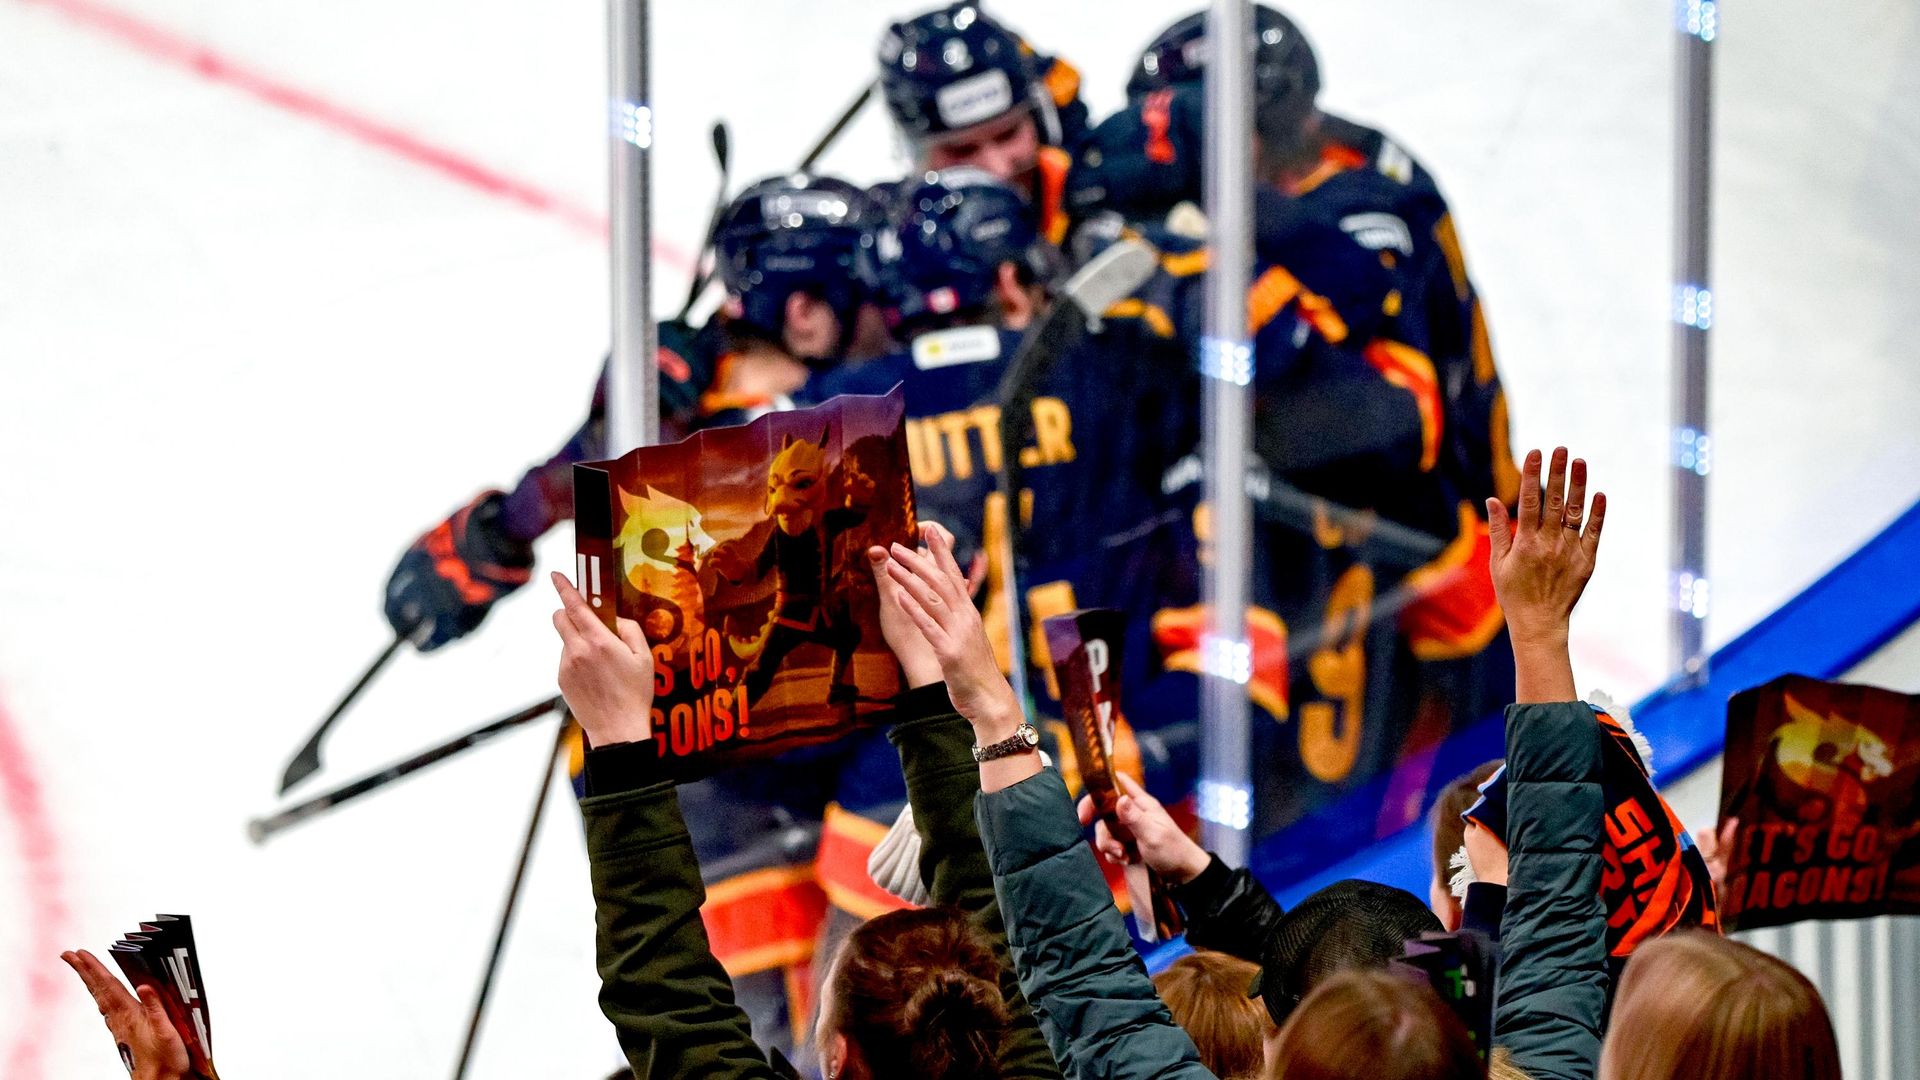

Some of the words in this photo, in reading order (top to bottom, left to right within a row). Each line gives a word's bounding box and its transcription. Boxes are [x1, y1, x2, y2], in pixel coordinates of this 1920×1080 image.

[904, 396, 1077, 487] UTTR
[690, 627, 737, 690] GO,
[650, 684, 750, 758] GONS!
